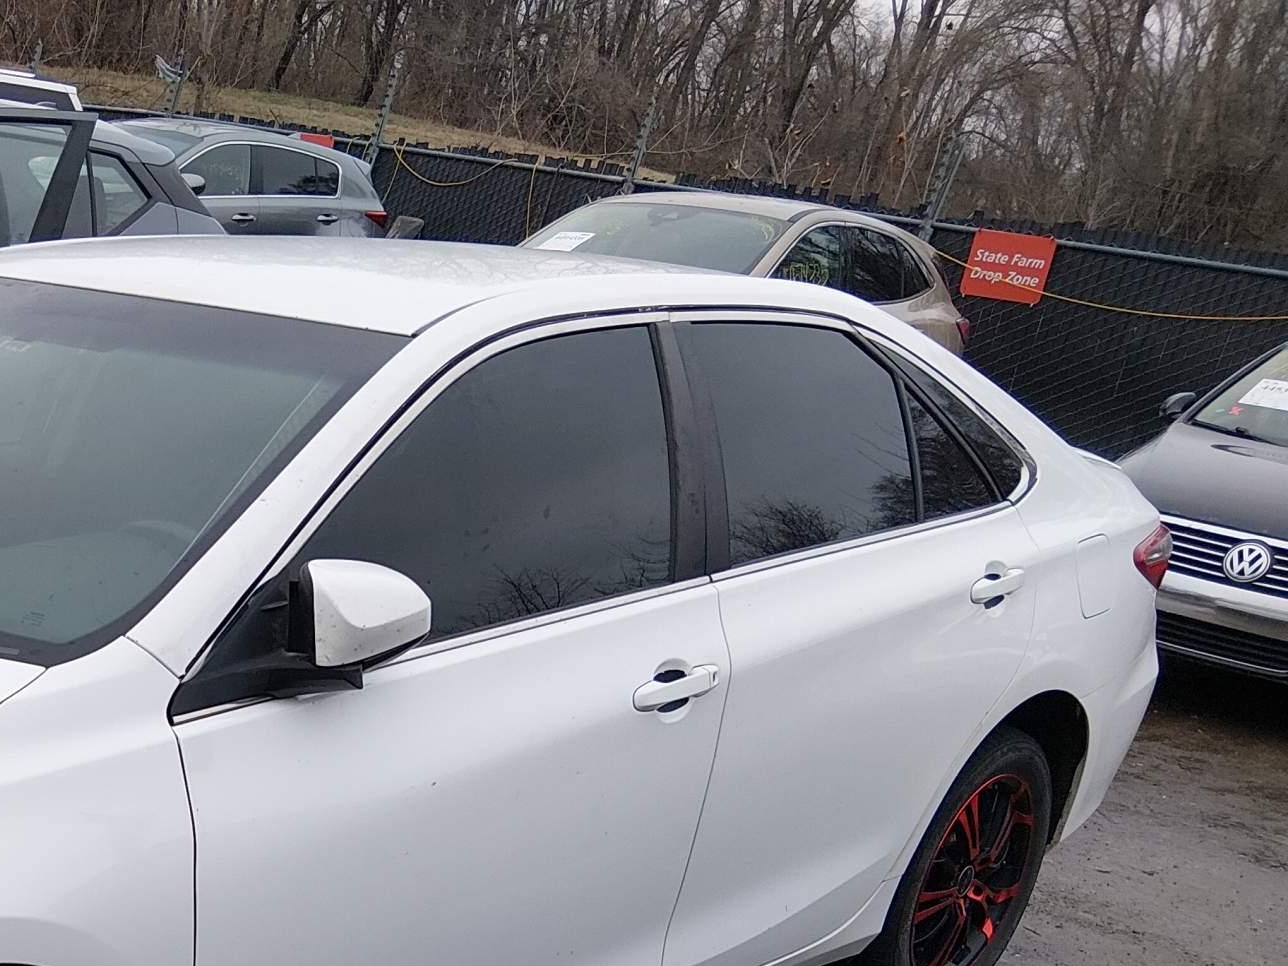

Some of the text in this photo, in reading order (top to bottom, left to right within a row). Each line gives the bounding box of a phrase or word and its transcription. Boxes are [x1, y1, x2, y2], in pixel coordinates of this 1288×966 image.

[974, 249, 1045, 269] State Farm
[970, 267, 1039, 287] Drop Zone
